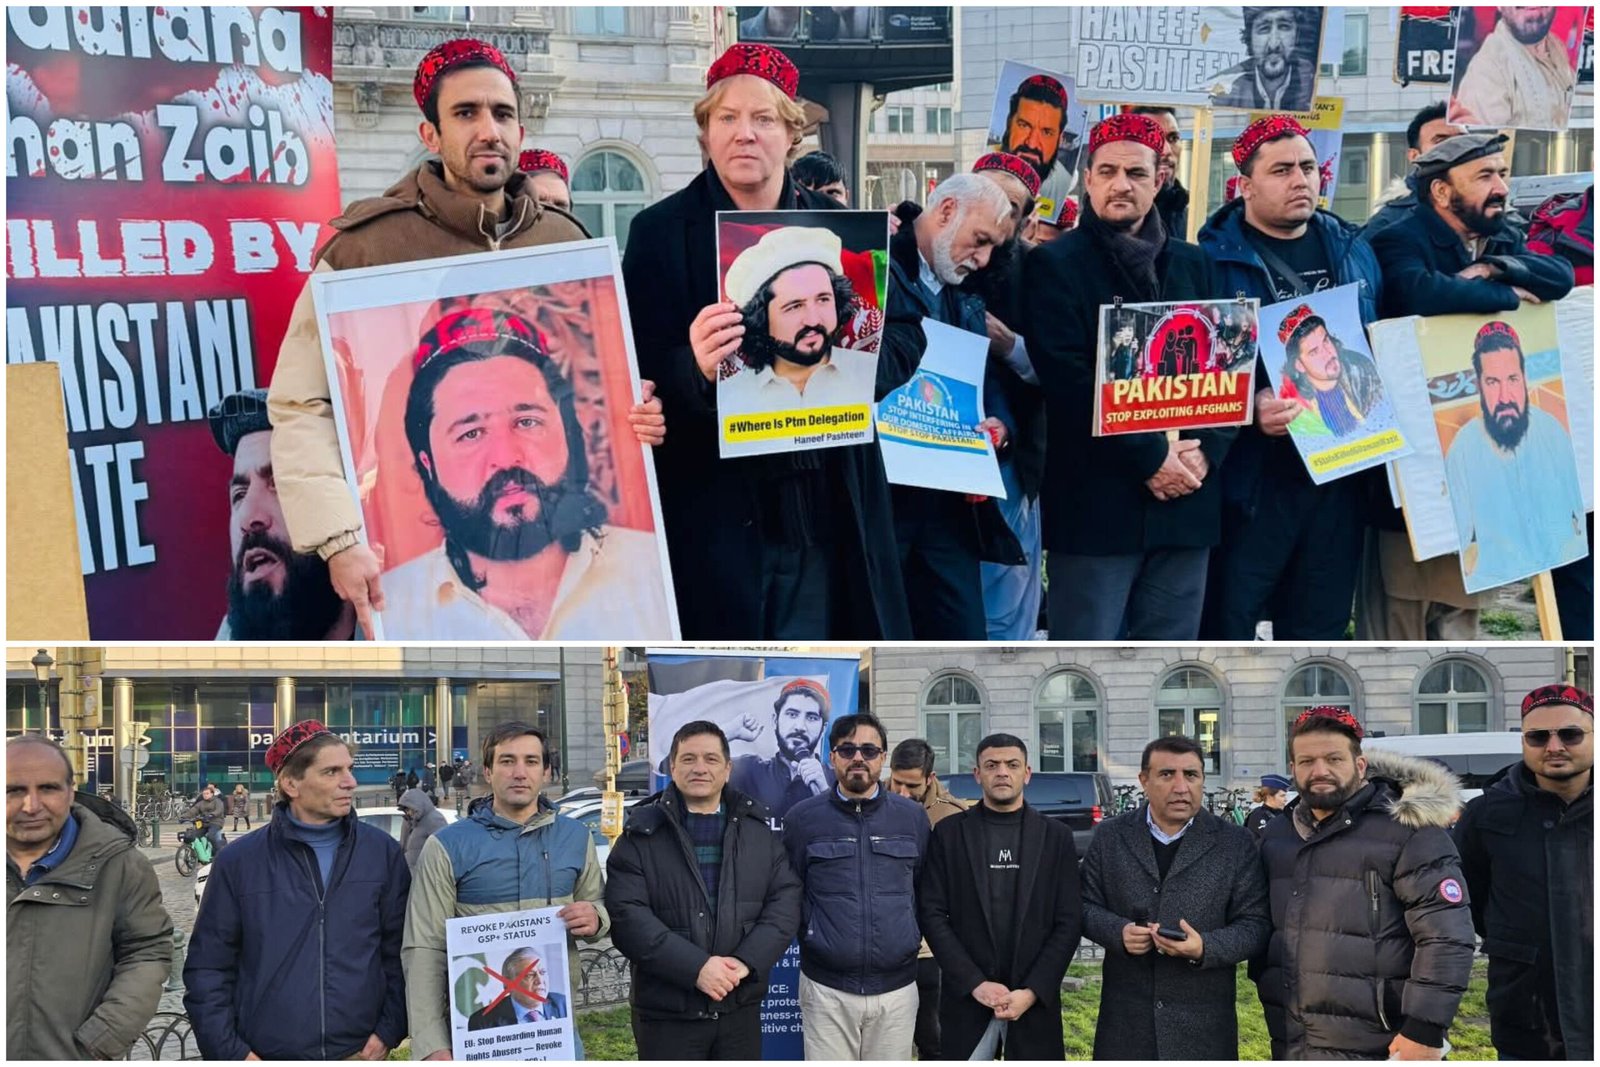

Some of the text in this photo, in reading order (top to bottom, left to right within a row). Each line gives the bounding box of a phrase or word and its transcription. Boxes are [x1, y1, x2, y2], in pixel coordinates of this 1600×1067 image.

[1080, 6, 1199, 46] HANEEF
[156, 104, 309, 185] Zaib
[228, 218, 320, 273] BY
[1113, 372, 1238, 405] PAKISTAN
[888, 405, 908, 417] STOP
[898, 394, 959, 421] PAKISTAN
[1106, 402, 1243, 424] STOP EXPLOITING AFGHANS
[730, 411, 865, 433] #Where Is Ptm Delegation
[881, 413, 899, 424] OUR
[900, 416, 941, 434] DOMESTIC
[794, 431, 865, 444] Haneef Pashteen
[461, 917, 551, 934] REVOKE PAKISTAN'S
[478, 929, 536, 943] GSP+ STATUS
[464, 1027, 562, 1048] EU: Stop Rewarding Human
[492, 1046, 522, 1058] Abusers
[536, 1041, 562, 1051] Revoke
